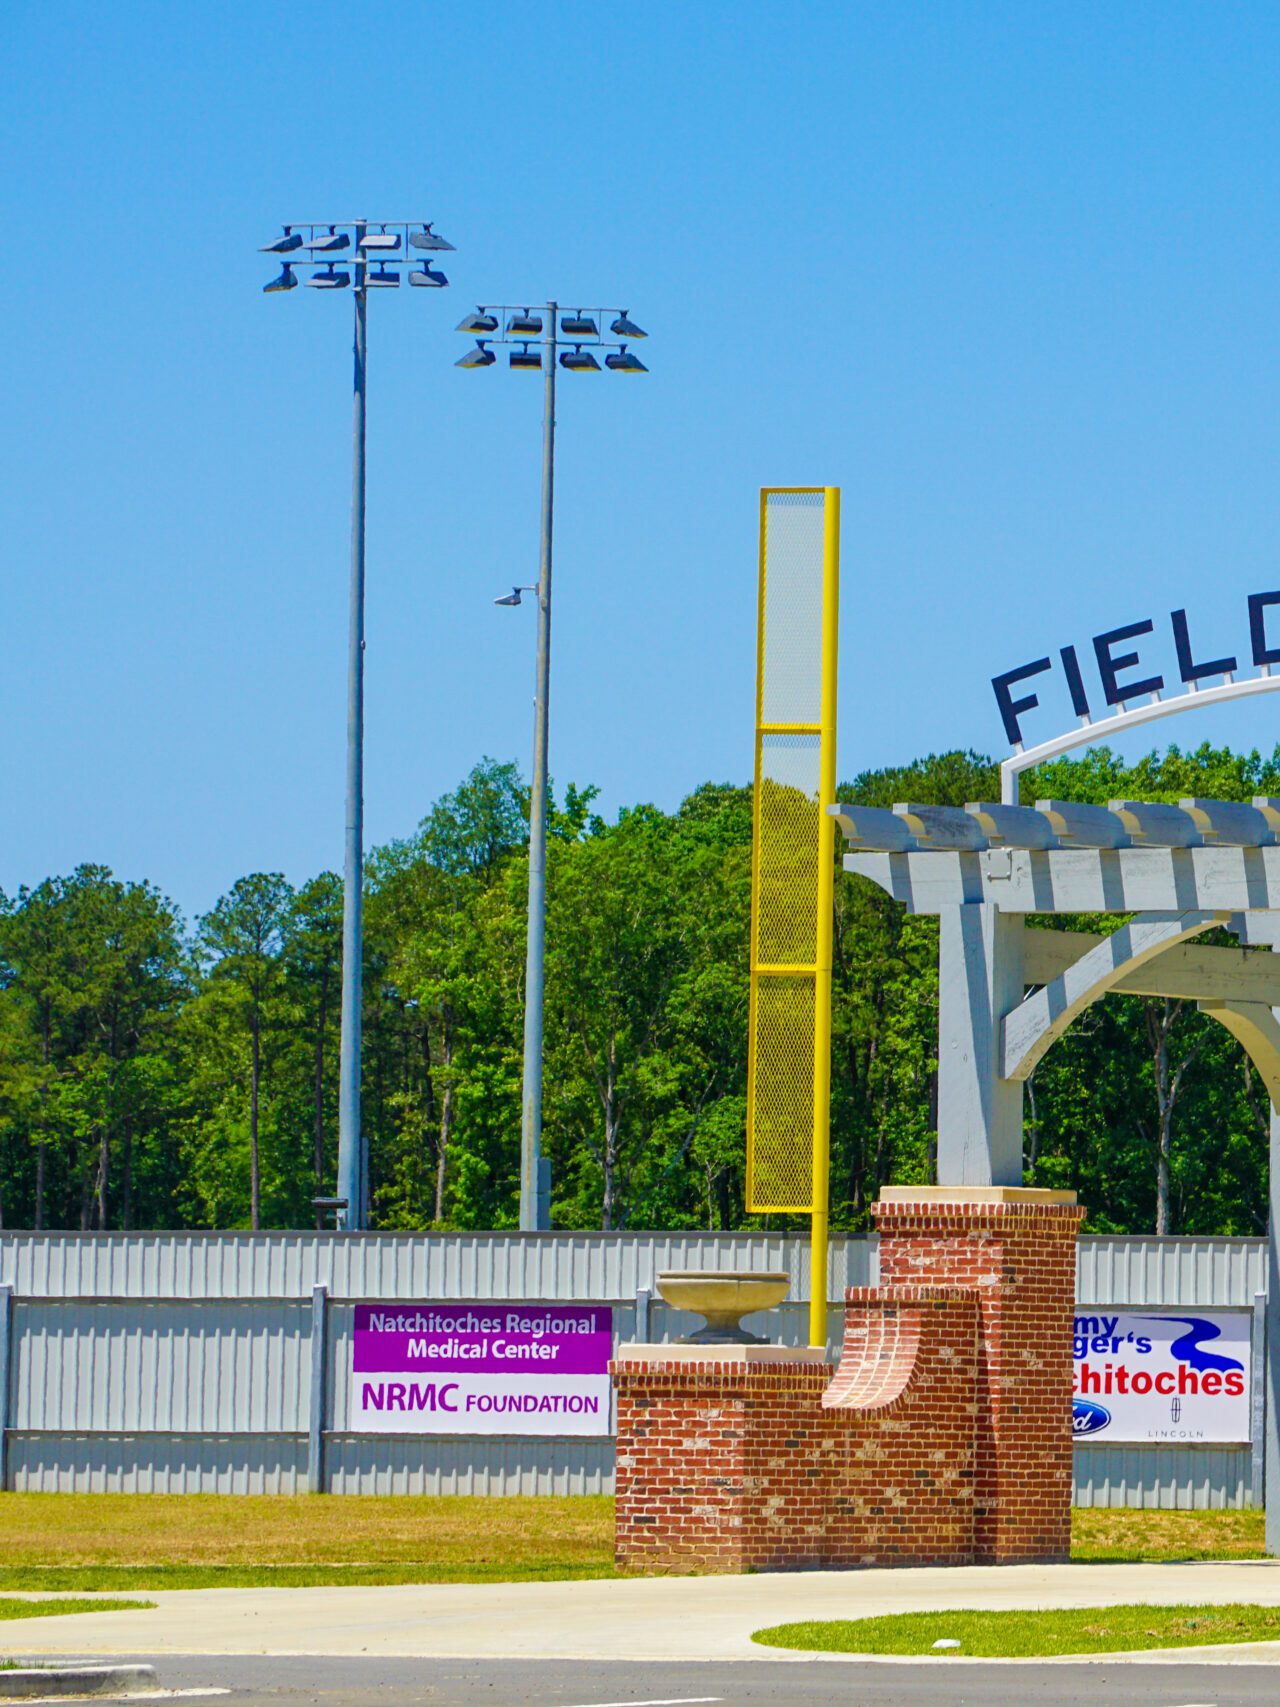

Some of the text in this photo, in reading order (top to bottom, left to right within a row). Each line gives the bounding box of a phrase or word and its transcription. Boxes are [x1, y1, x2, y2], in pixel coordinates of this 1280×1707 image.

[369, 1312, 596, 1338] Natchitoches Regional
[407, 1337, 560, 1360] Medical Center
[1073, 1329, 1152, 1360] ger's
[1073, 1363, 1245, 1396] hitoches
[361, 1382, 599, 1414] NRMC FOUNDATION
[1147, 1430, 1204, 1438] LINCOLN
